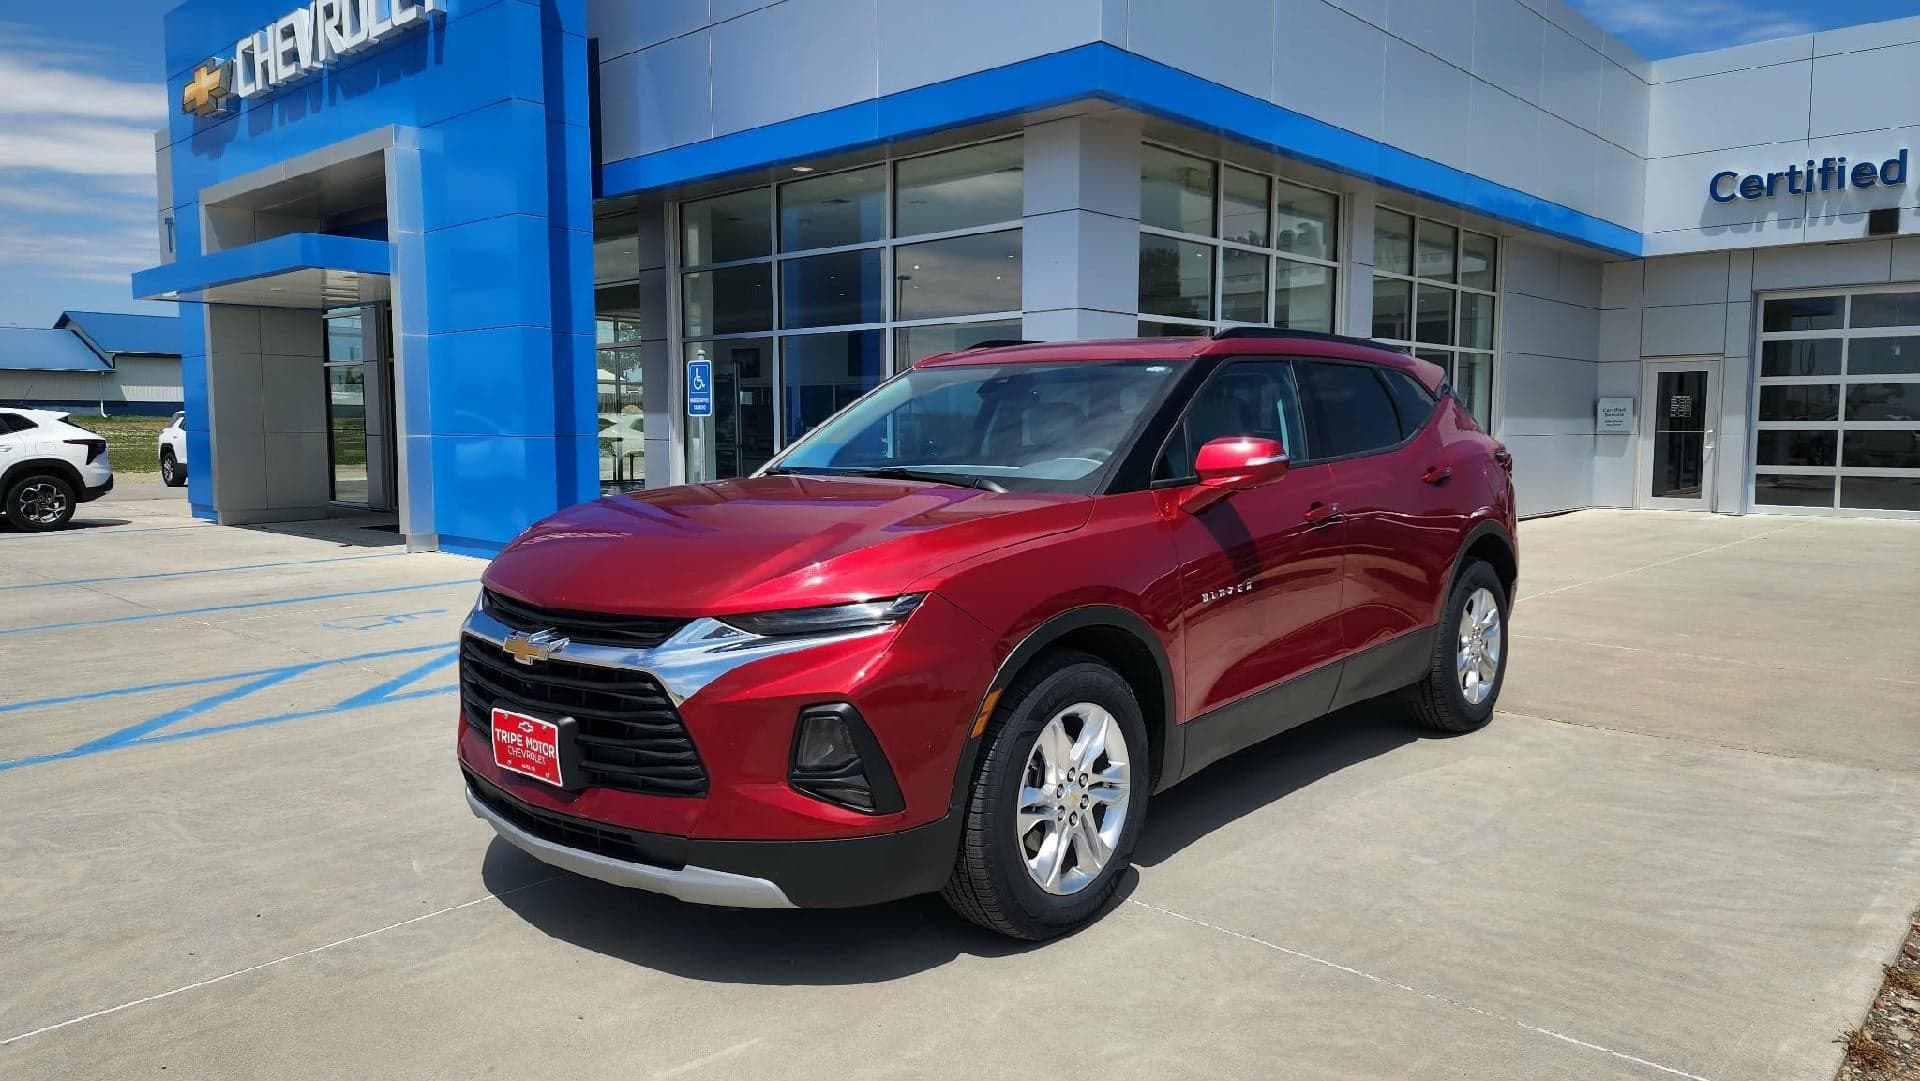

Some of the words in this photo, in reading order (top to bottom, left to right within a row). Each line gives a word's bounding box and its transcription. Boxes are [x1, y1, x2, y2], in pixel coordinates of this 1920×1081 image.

[235, 0, 446, 98] CHEVROL
[1709, 148, 1908, 203] Certified
[495, 728, 523, 747] TRIPE
[525, 736, 555, 759] MOTOR
[507, 745, 546, 765] CHEVROLET
